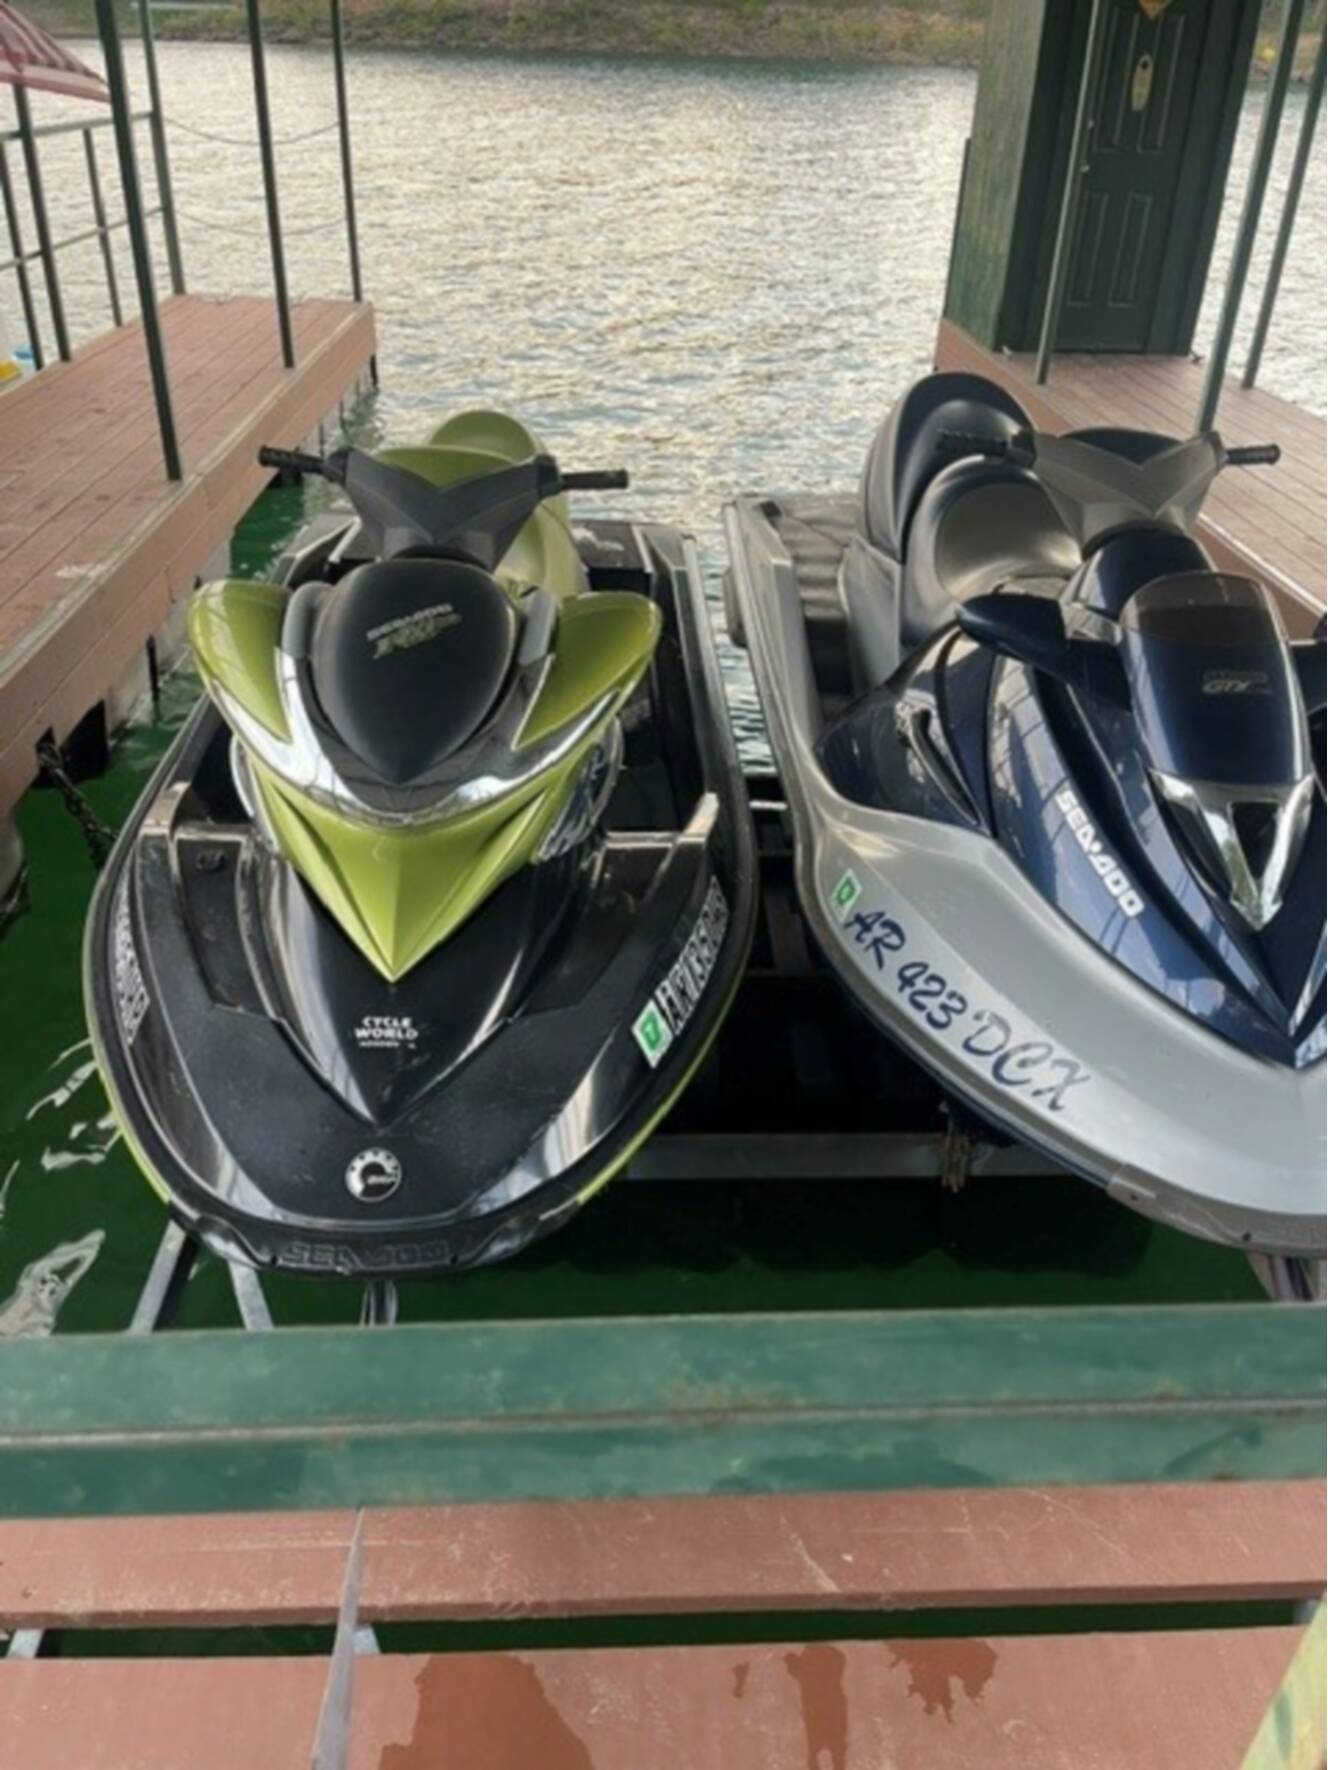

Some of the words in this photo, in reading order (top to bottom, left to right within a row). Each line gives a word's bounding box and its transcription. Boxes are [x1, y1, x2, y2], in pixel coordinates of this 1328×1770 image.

[844, 911, 907, 971] AR
[897, 961, 969, 1030] 423
[962, 1009, 1092, 1111] DCX
[362, 1015, 413, 1028] CYCLE
[354, 1027, 419, 1040] WORLD
